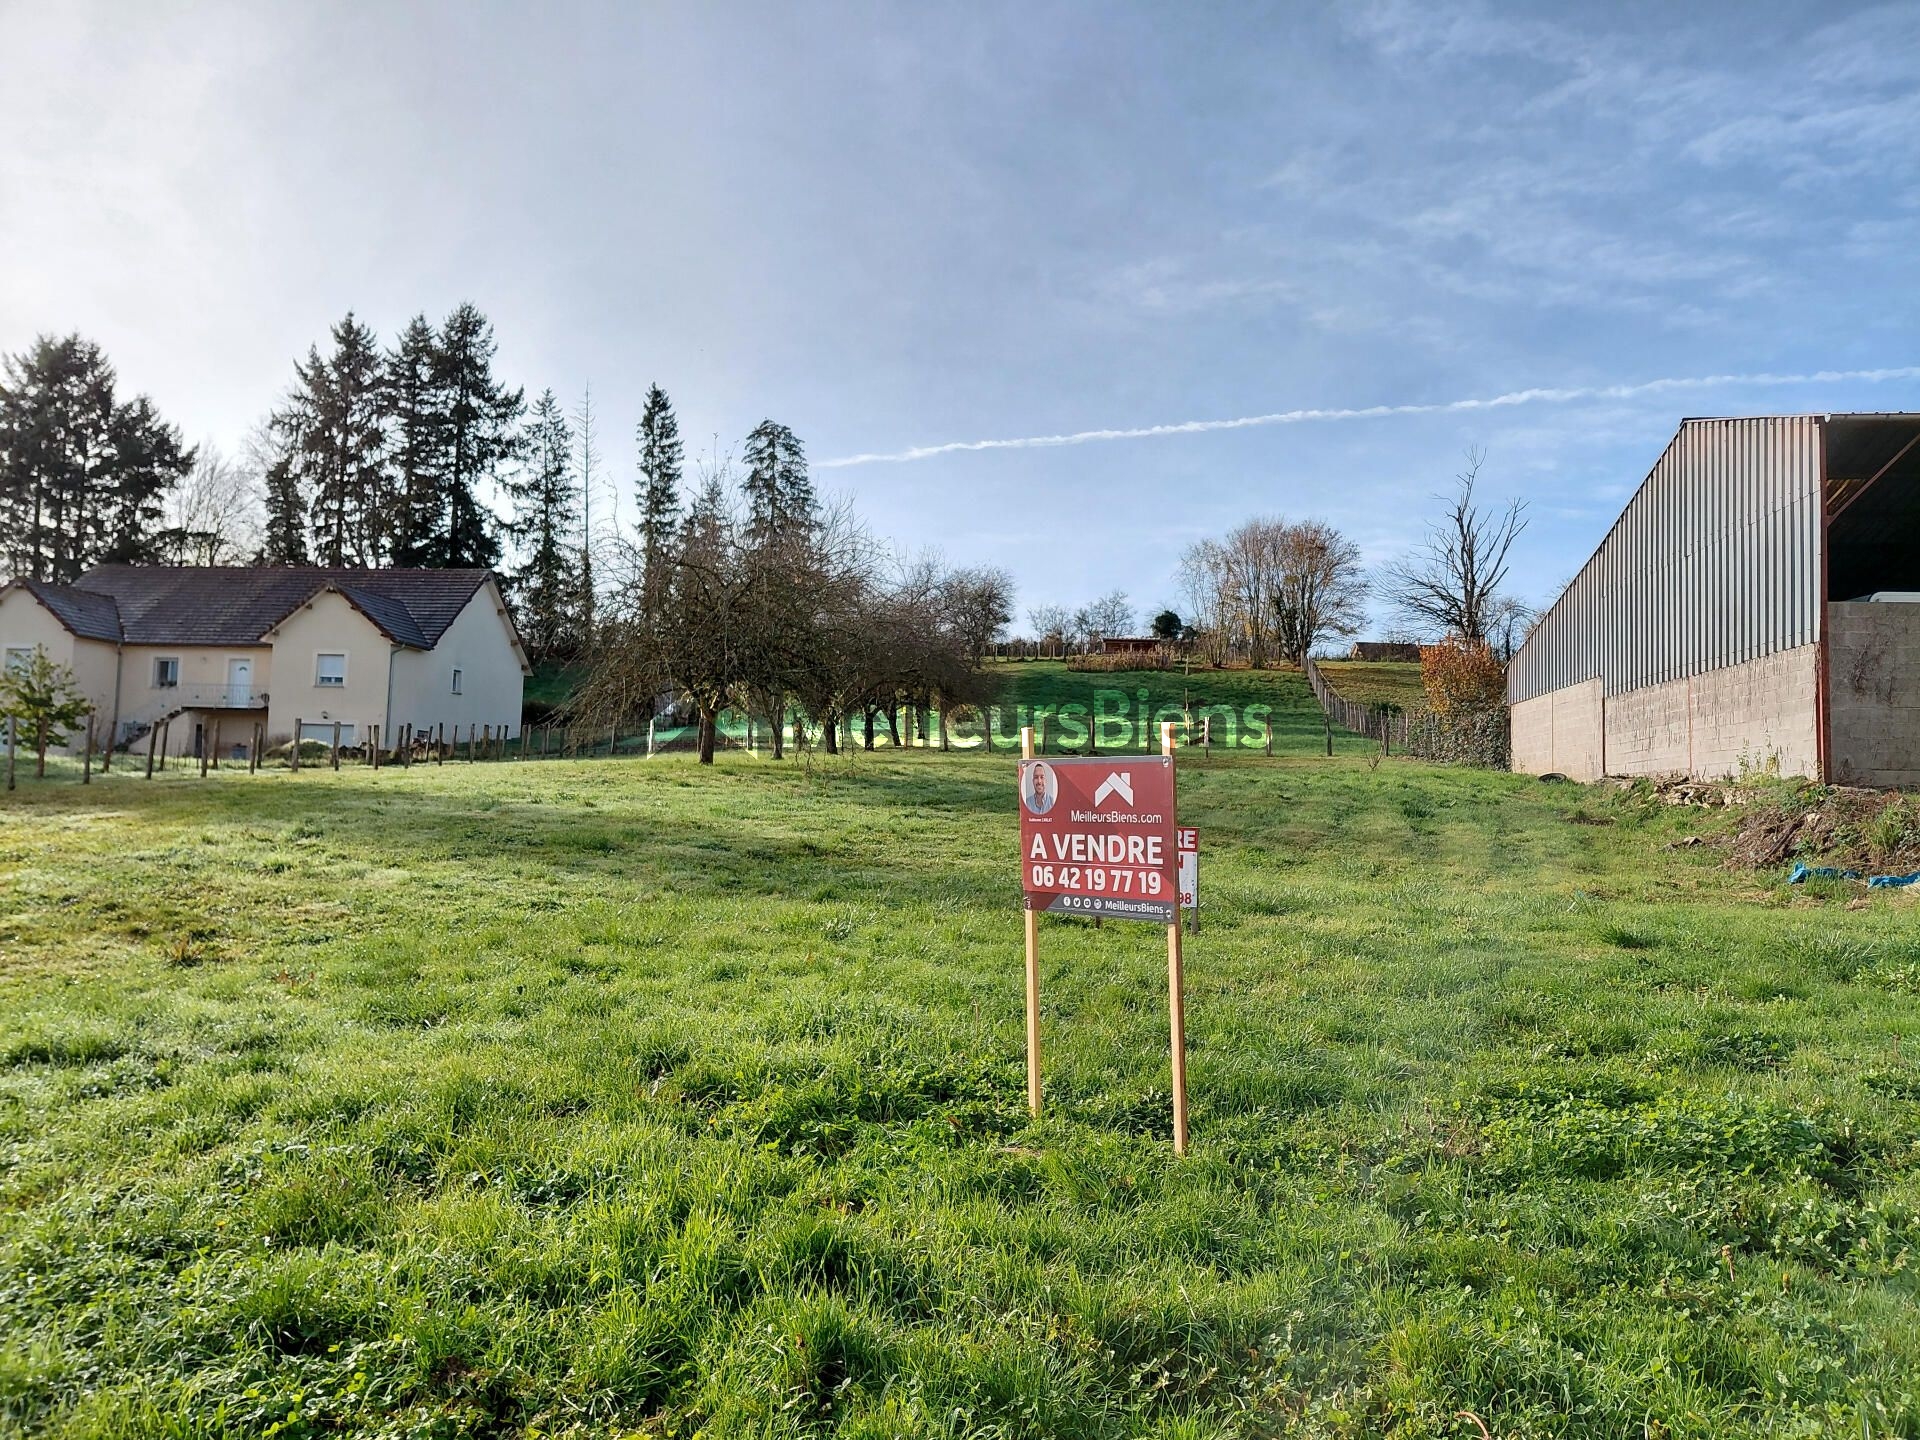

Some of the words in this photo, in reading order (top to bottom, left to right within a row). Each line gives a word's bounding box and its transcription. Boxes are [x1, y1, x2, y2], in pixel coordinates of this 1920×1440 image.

[1071, 810, 1162, 824] MeilleursBiens.com
[1030, 833, 1048, 859] A
[1052, 833, 1163, 865] VENDRE
[1032, 865, 1054, 887] 06
[1058, 867, 1080, 889] 42
[1085, 868, 1106, 891] 19
[1110, 870, 1133, 893] 77
[1138, 871, 1161, 894] 19
[1105, 900, 1164, 914] MeilleursBiens
